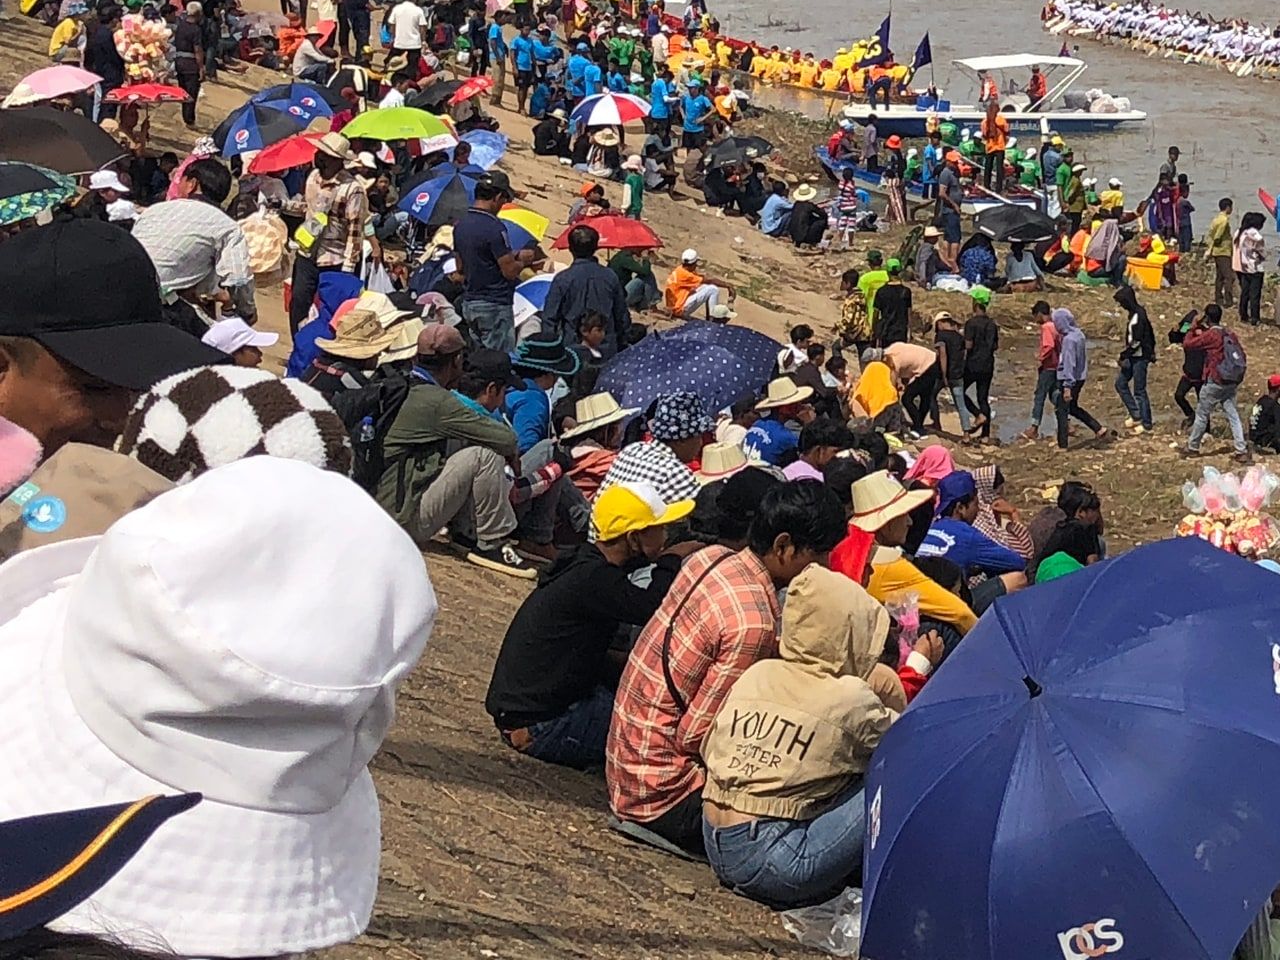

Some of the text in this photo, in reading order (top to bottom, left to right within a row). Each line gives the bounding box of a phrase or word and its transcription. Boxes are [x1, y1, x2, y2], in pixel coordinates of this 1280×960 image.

[730, 709, 816, 762] YOUTH
[727, 756, 761, 779] DAY
[1057, 918, 1124, 960] pcs
